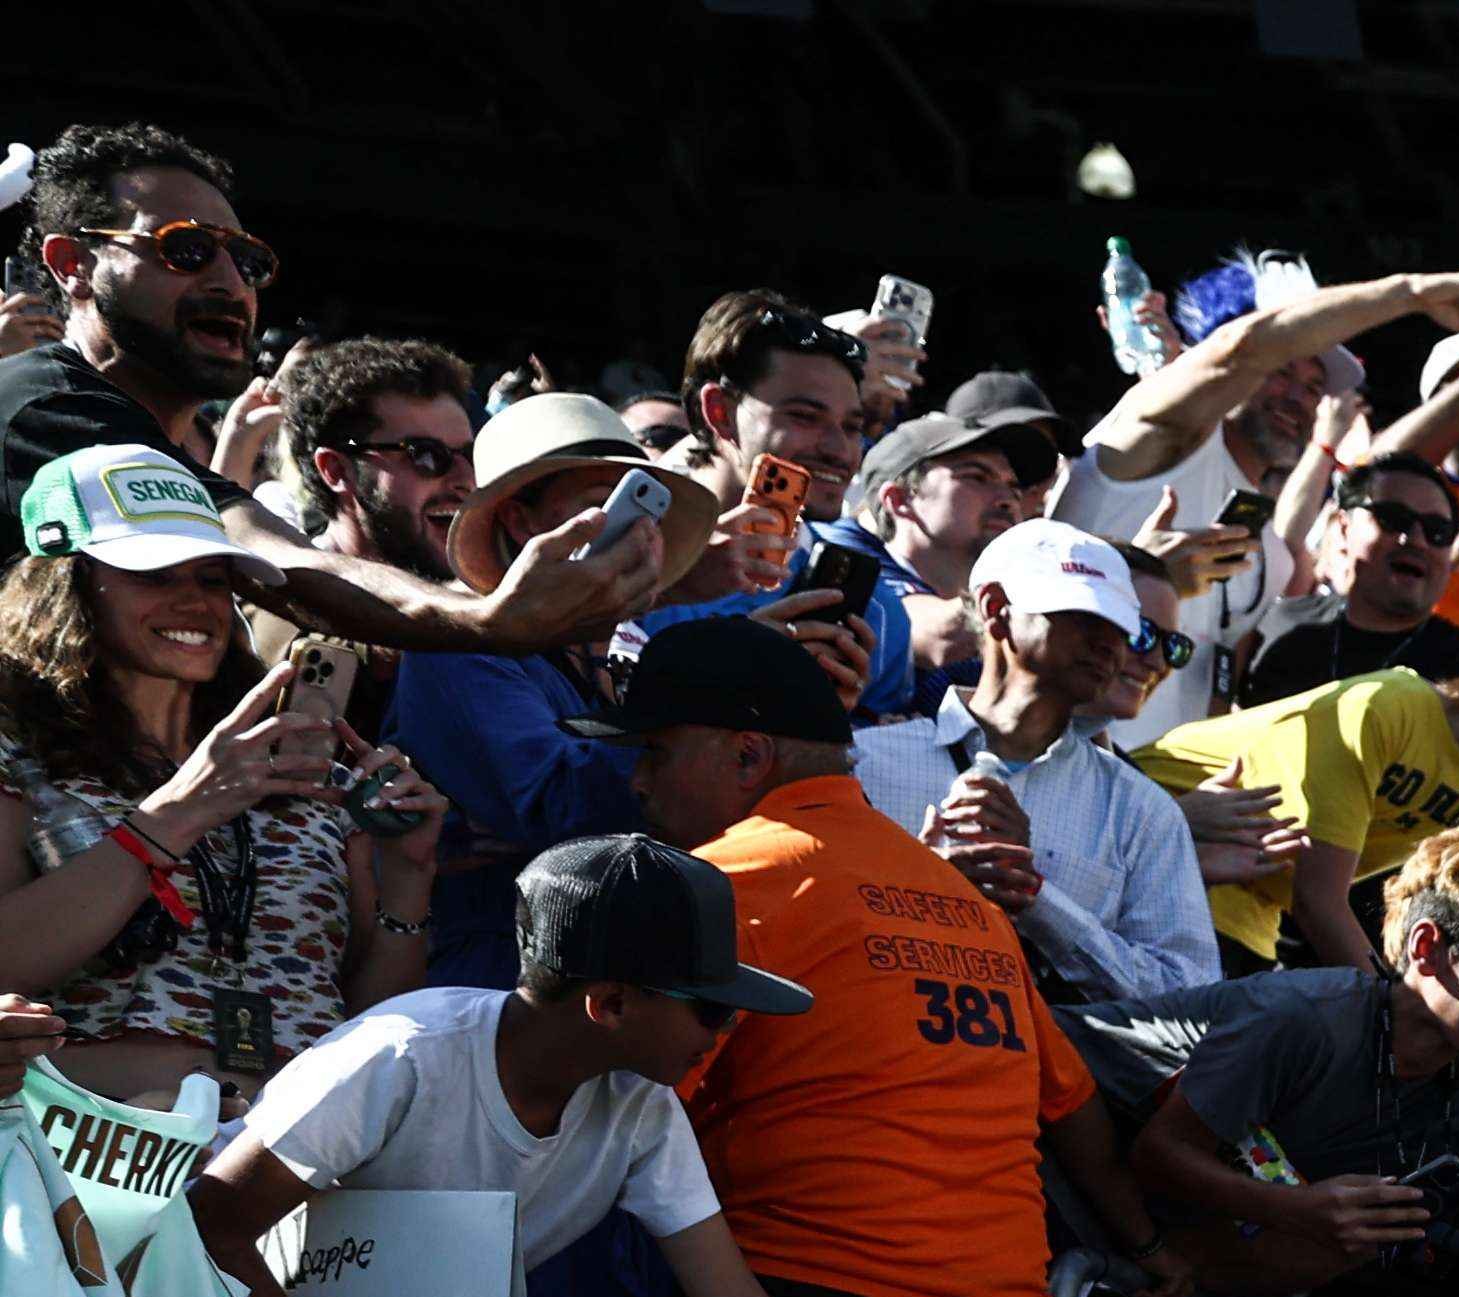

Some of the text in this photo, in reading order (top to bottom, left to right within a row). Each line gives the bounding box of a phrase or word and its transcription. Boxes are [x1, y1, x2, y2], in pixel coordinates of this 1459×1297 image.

[857, 884, 989, 931] SAFETY
[864, 934, 1020, 987] SERVICES
[914, 978, 1027, 1053] 381
